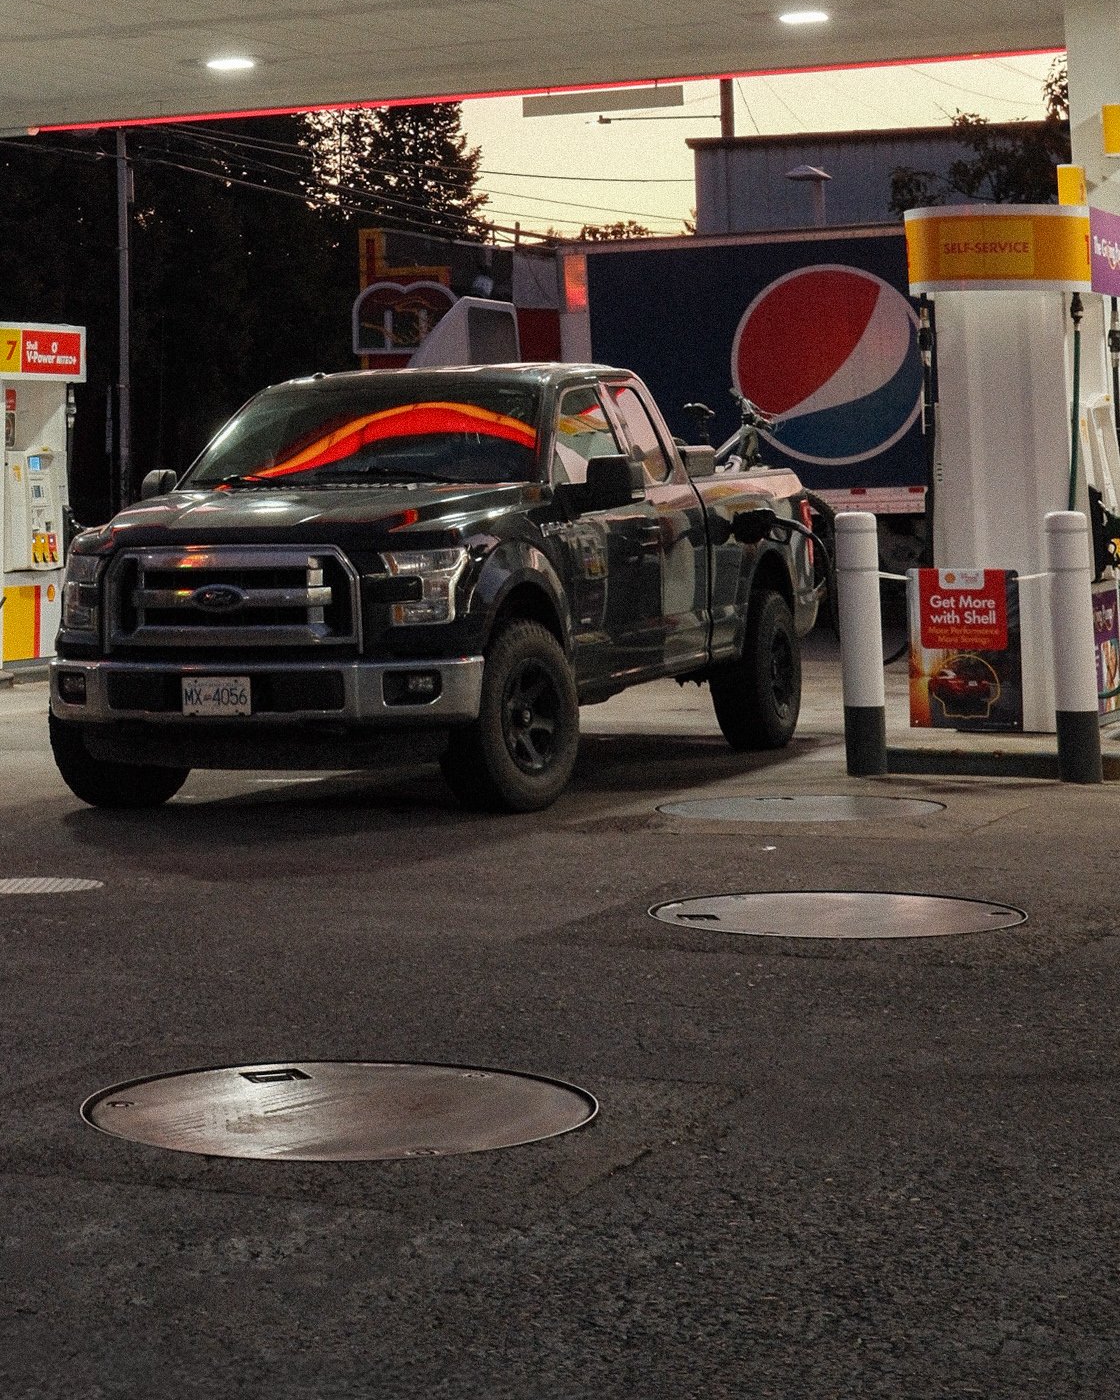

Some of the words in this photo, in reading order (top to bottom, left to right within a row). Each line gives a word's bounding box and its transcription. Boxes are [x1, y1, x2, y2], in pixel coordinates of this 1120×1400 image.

[943, 241, 1029, 254] SELF-SERVICE
[6, 340, 18, 361] 7
[930, 595, 955, 609] Get
[959, 595, 996, 609] More
[930, 610, 960, 624] with
[964, 610, 996, 625] Shell
